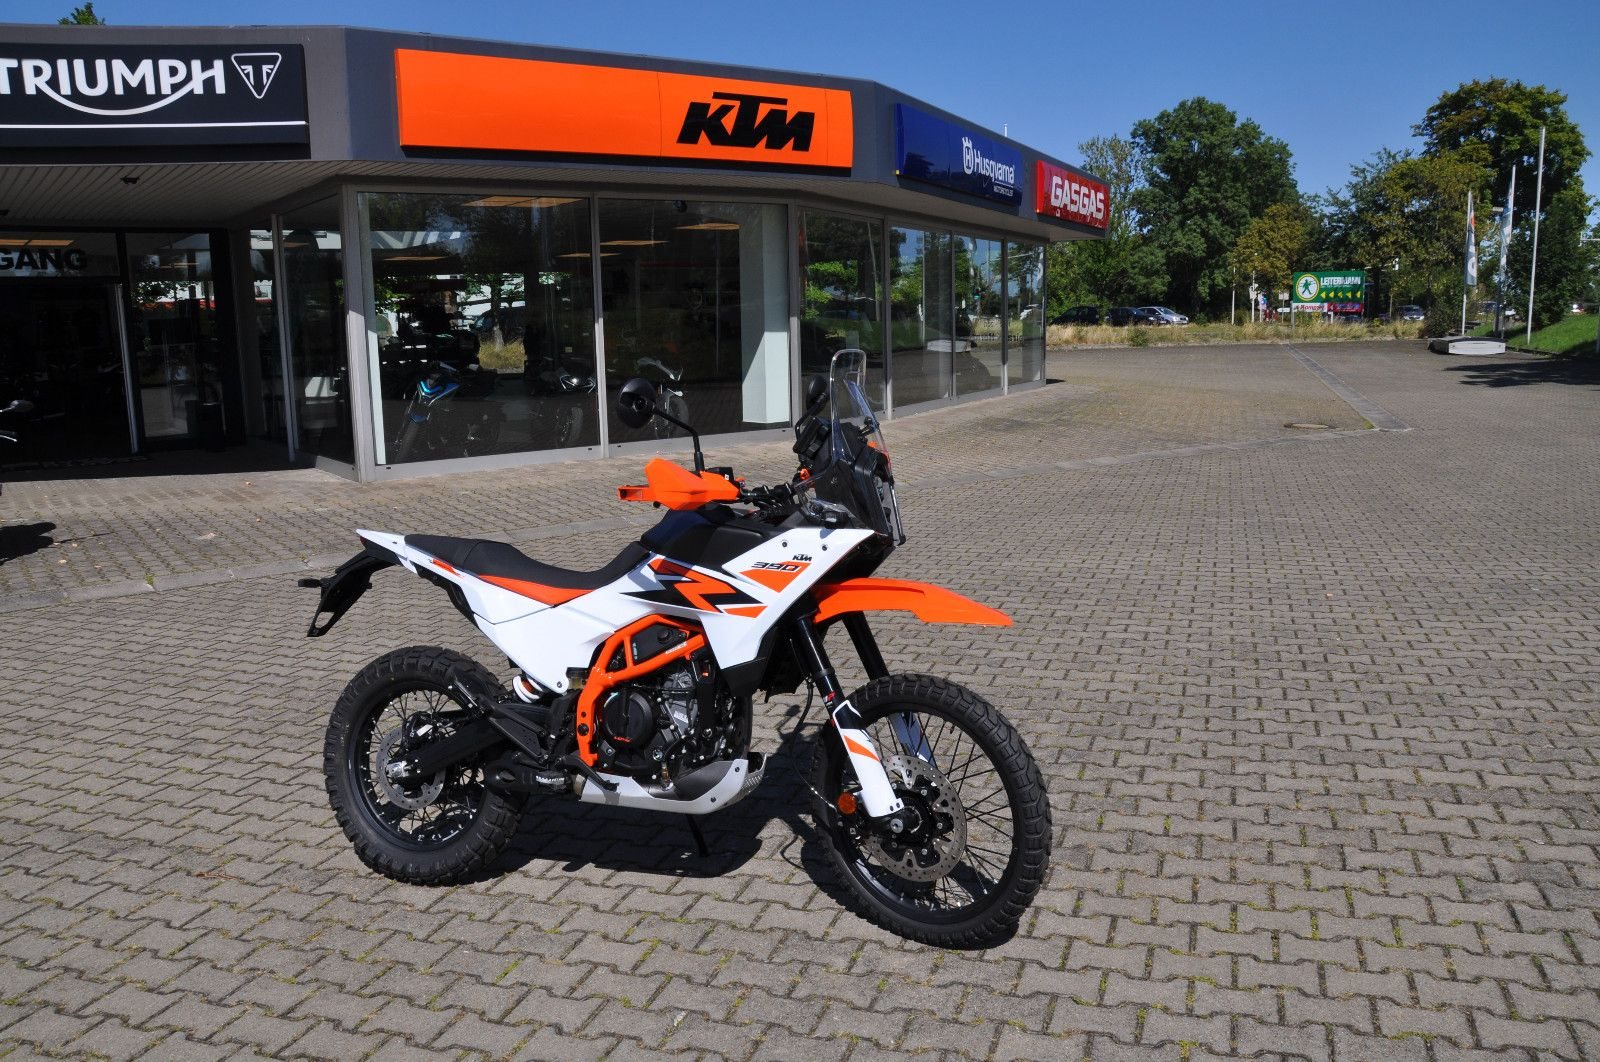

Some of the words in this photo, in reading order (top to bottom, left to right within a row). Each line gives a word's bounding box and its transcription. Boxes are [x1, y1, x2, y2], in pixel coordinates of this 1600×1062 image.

[0, 58, 226, 115] TRIUMPH
[676, 91, 815, 152] KTM
[973, 148, 1015, 184] Husqvarna
[1050, 175, 1105, 220] GASGAS
[751, 561, 800, 572] 390
[792, 553, 813, 562] KTM
